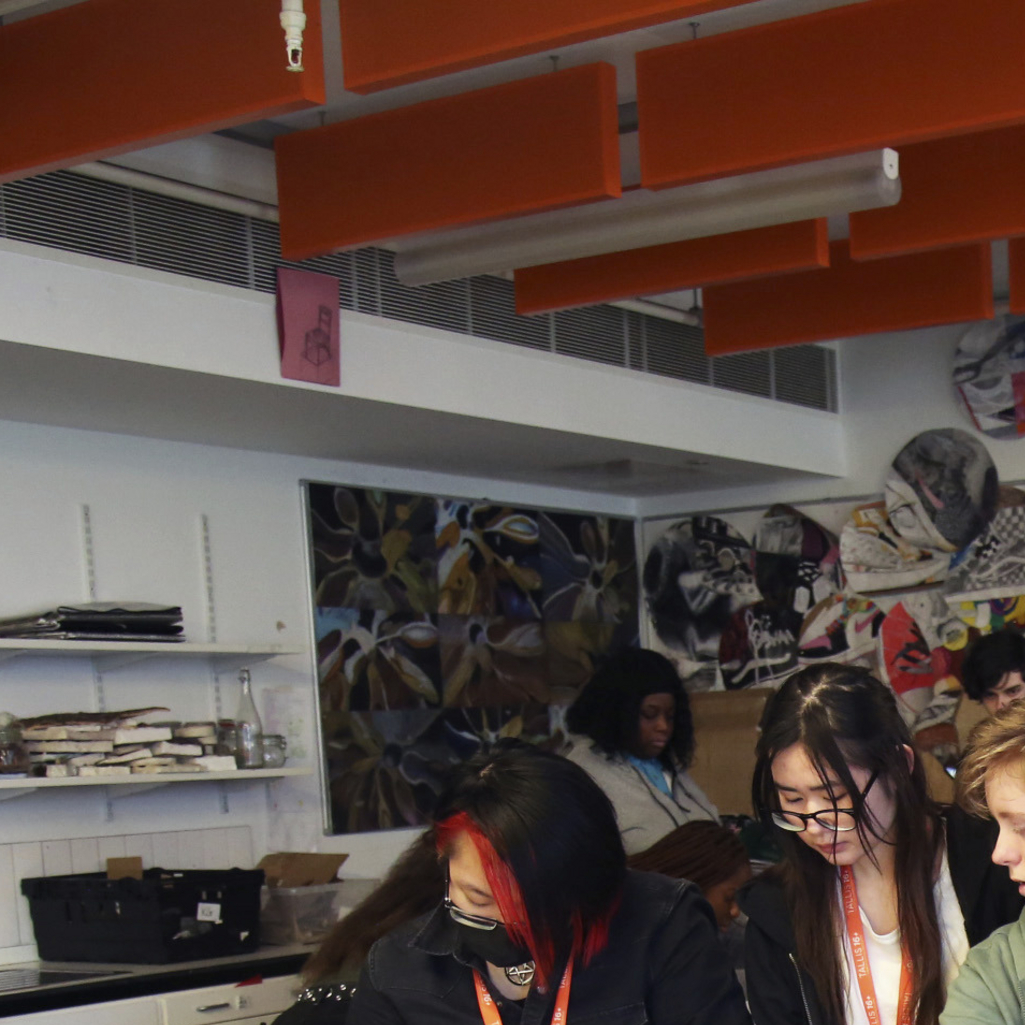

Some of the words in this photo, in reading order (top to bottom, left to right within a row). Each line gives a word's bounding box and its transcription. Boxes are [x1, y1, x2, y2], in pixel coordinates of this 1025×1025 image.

[852, 931, 860, 946] 16+
[853, 947, 865, 978] TALLIS
[866, 995, 874, 1010] 16+
[553, 1007, 562, 1021] 16+
